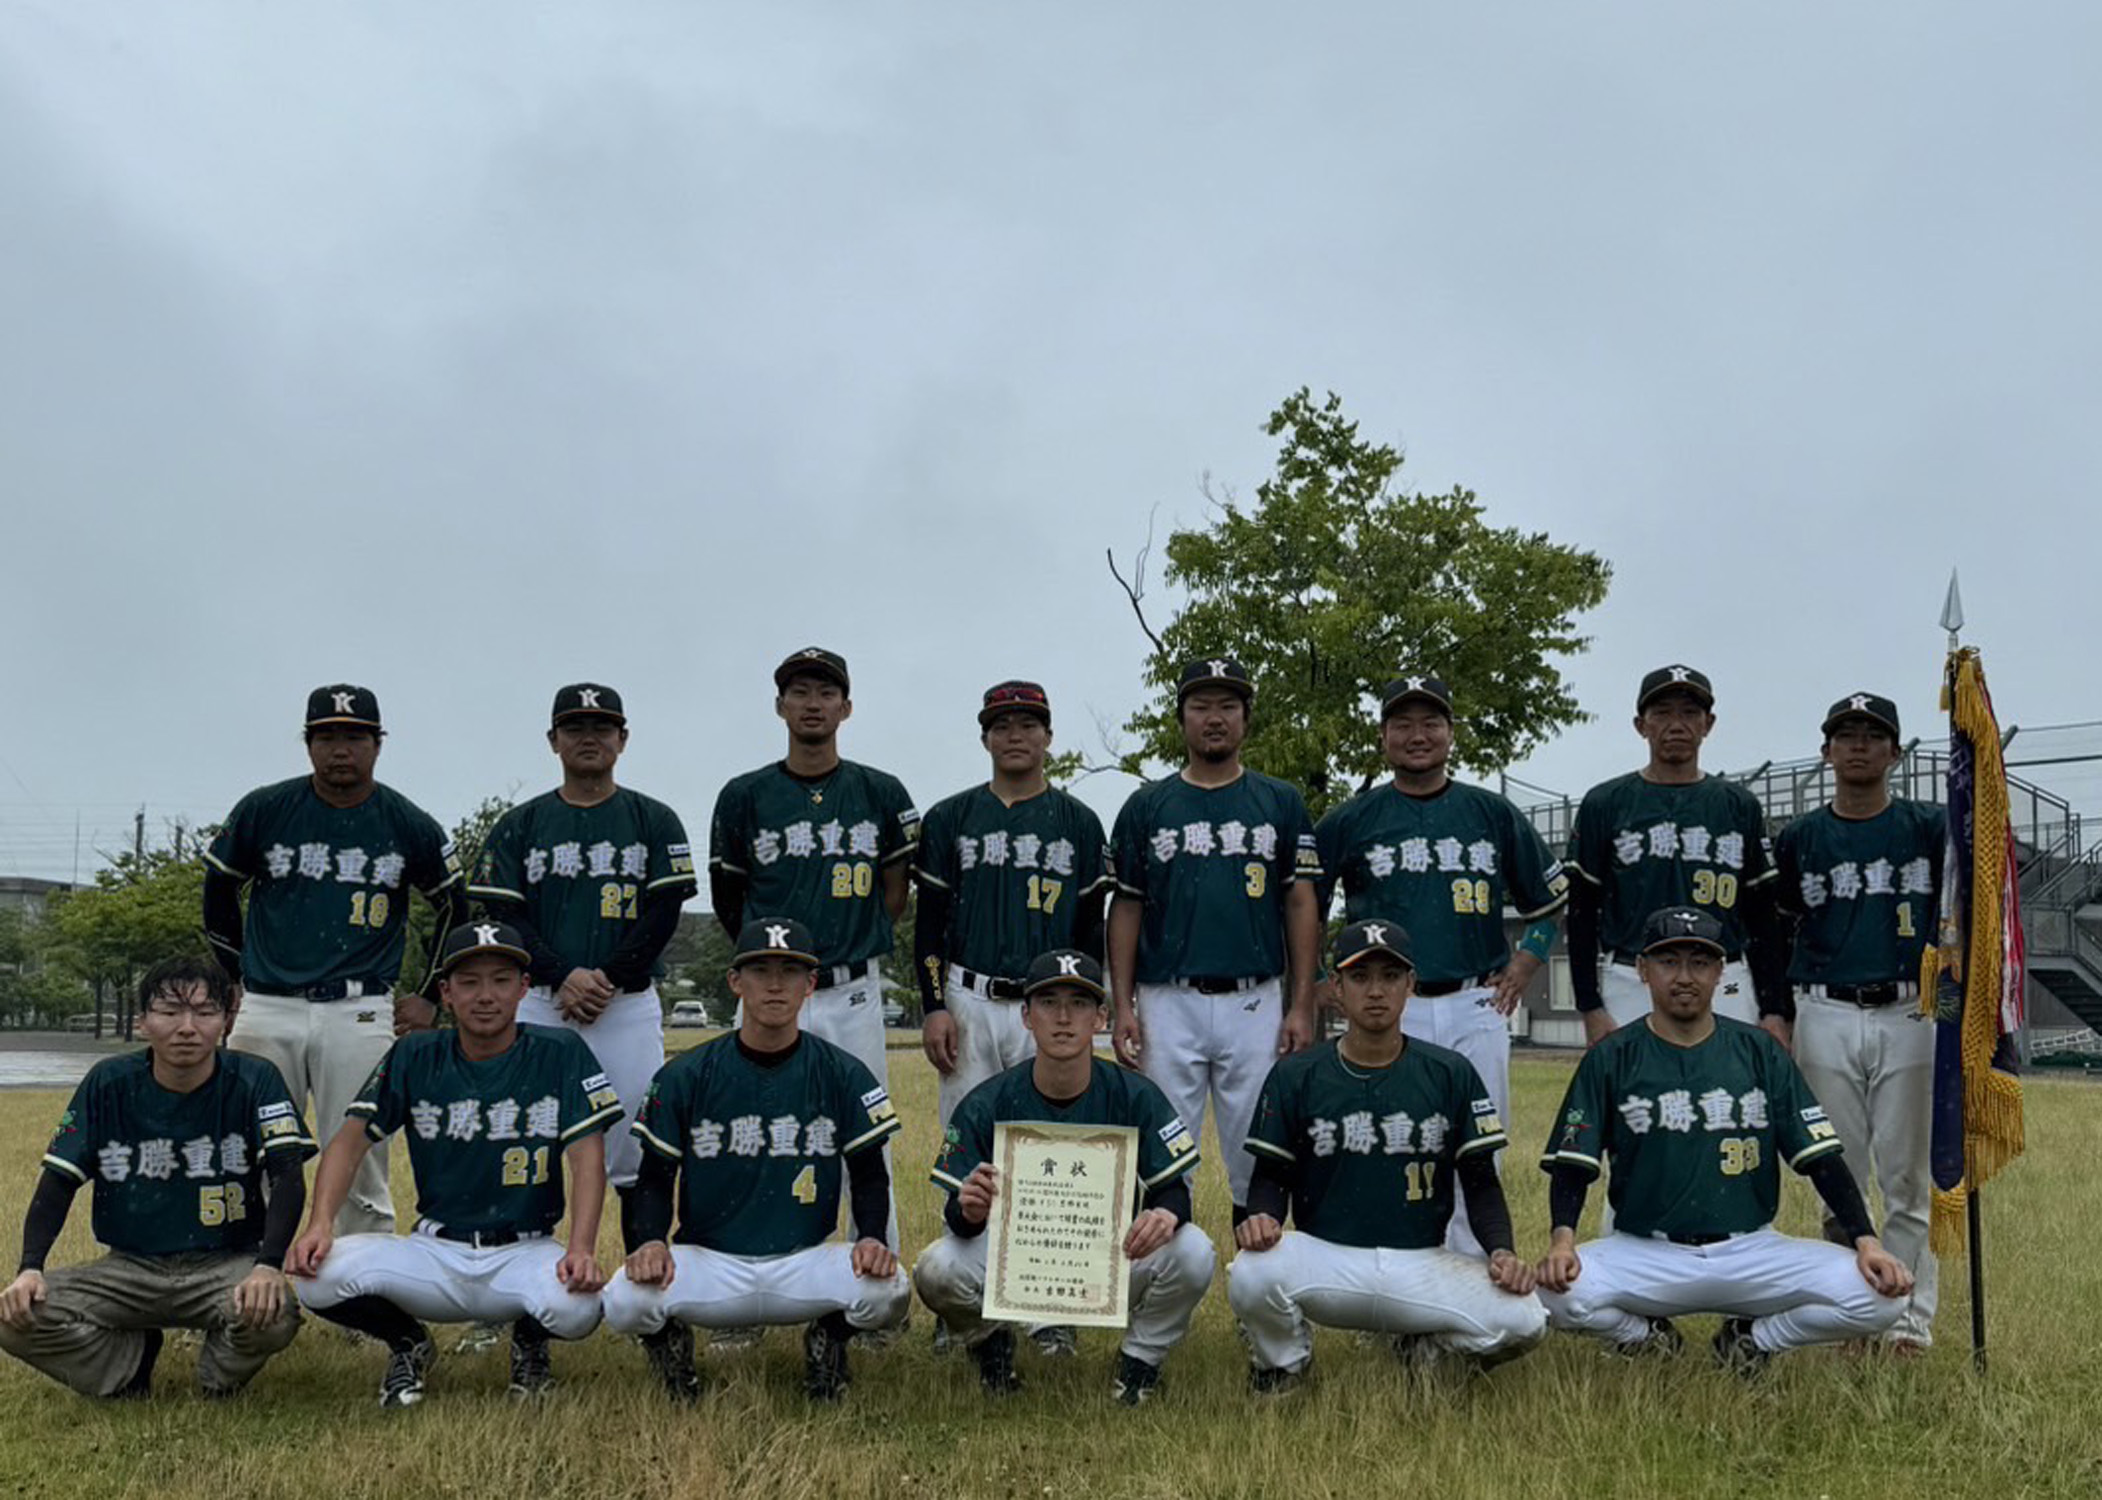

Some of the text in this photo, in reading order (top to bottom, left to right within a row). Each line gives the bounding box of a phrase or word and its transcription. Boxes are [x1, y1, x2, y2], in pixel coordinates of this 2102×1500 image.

[331, 692, 355, 713] K
[578, 689, 600, 708] K
[832, 861, 872, 897] 20
[1026, 873, 1062, 914] 17
[1245, 862, 1267, 898] 3
[1692, 869, 1738, 909] 30
[600, 882, 637, 919] 27
[474, 924, 499, 947] K
[765, 924, 790, 949] K
[1363, 924, 1388, 945] K
[1897, 902, 1915, 937] 1
[1056, 955, 1082, 977] K
[502, 1146, 549, 1186] 21
[791, 1164, 817, 1204] 4
[199, 1182, 246, 1226] 52
